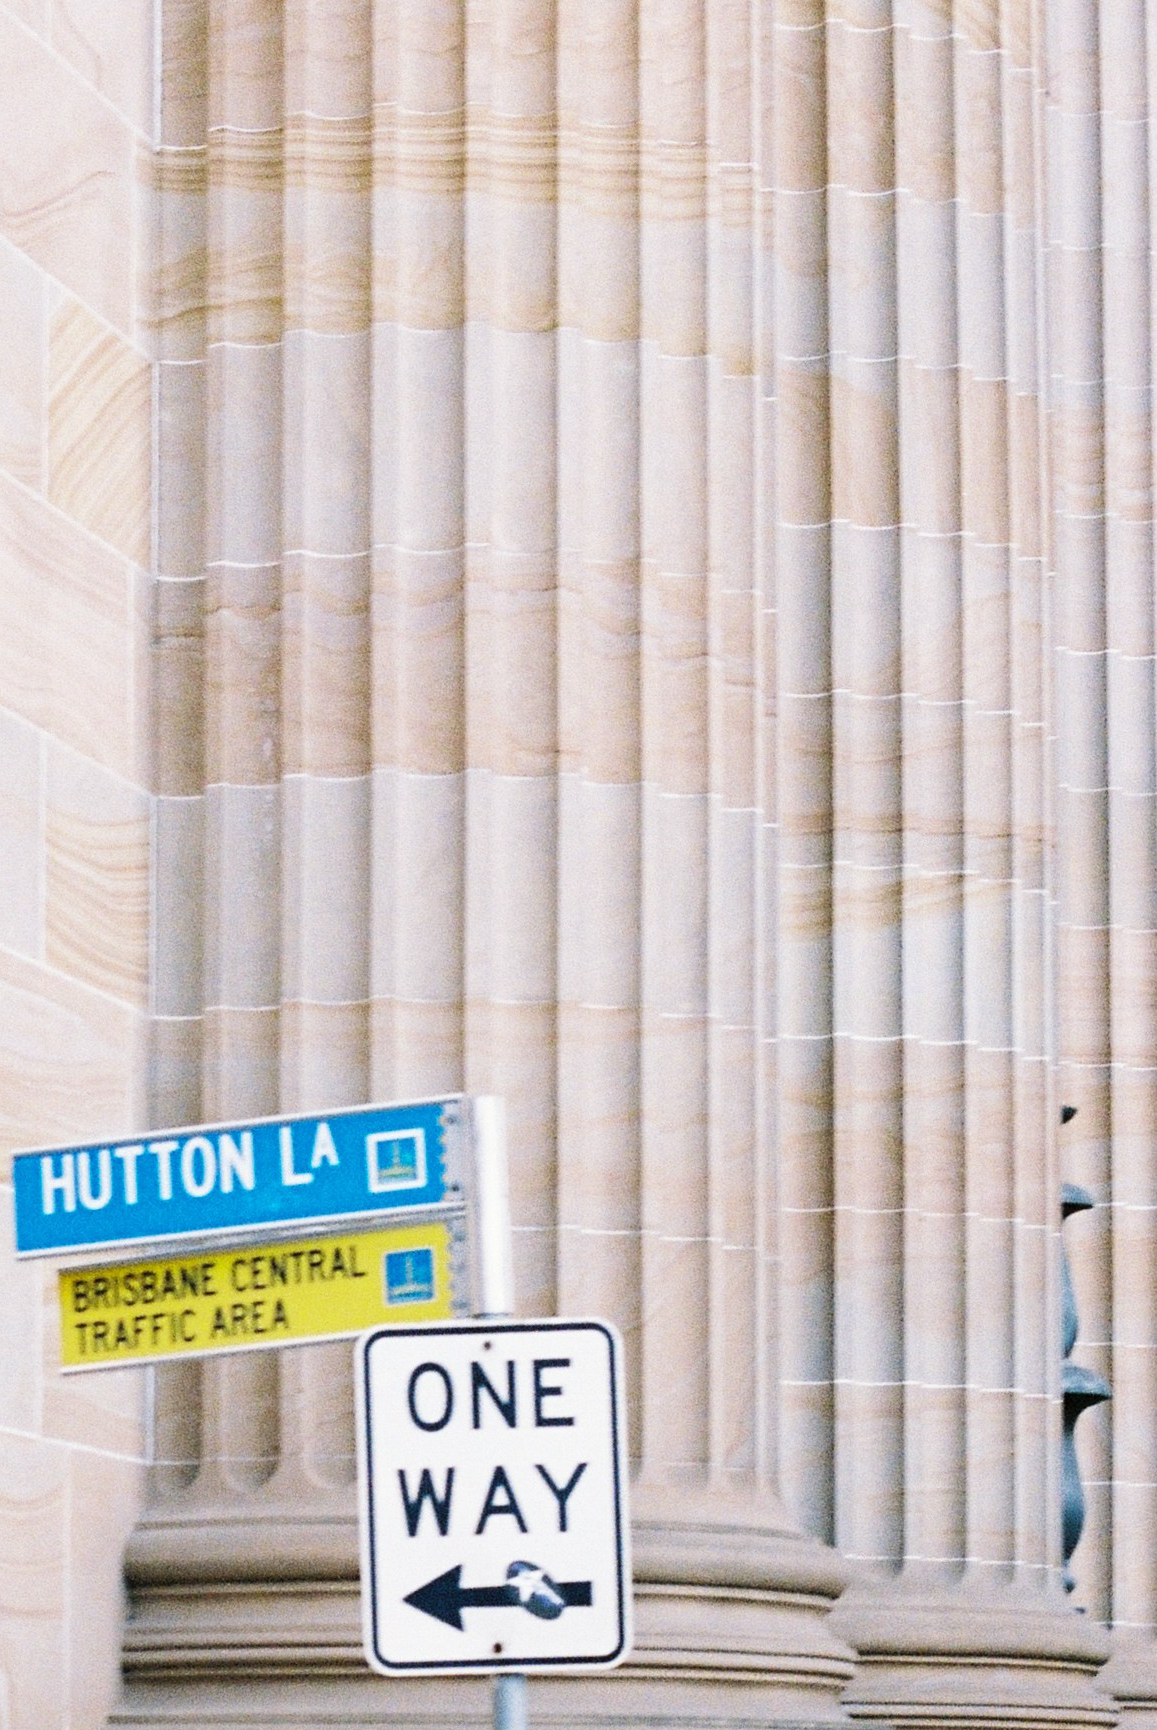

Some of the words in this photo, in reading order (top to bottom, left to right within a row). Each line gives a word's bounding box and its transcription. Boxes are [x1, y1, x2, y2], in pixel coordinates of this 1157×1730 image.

[40, 1136, 256, 1216] HUTTON
[279, 1122, 340, 1187] LA
[72, 1260, 217, 1313] BRISBANE
[230, 1244, 368, 1294] CENTRAL
[73, 1309, 197, 1356] TRAFFIC
[209, 1300, 290, 1340] AREA
[406, 1357, 575, 1433] ONE
[397, 1461, 588, 1538] WAY
